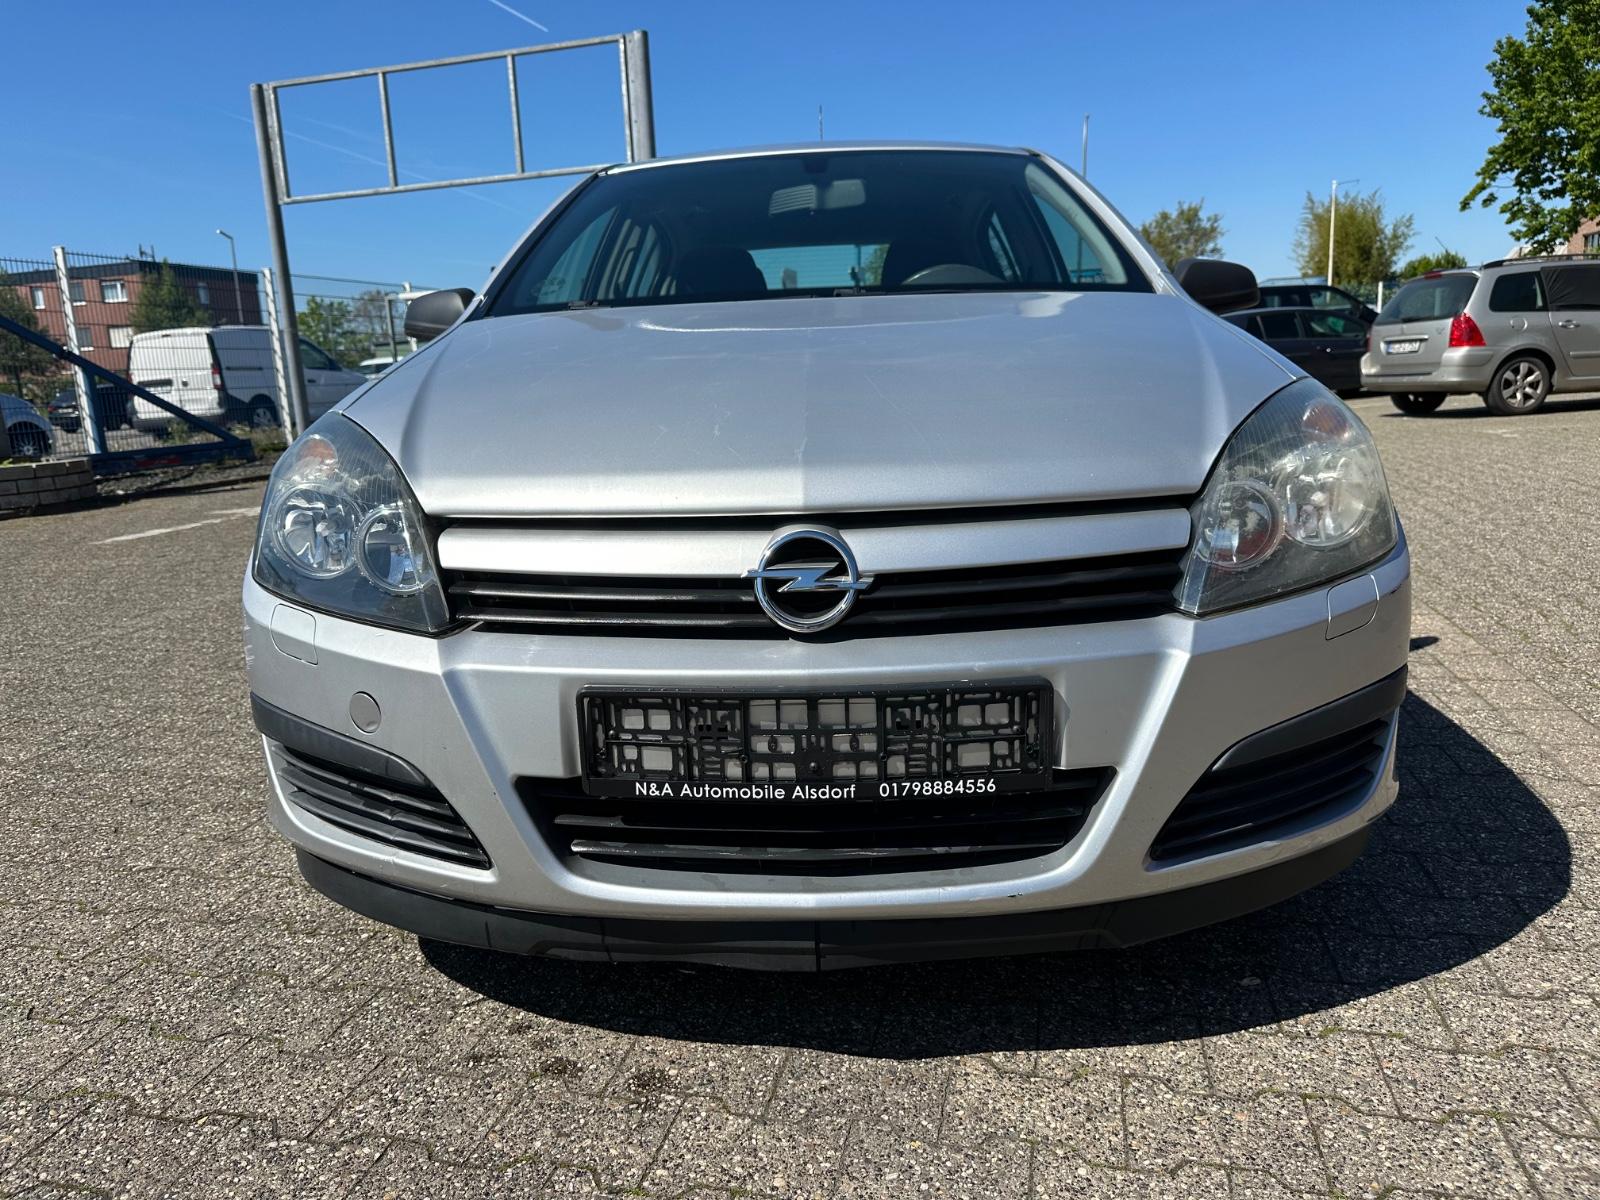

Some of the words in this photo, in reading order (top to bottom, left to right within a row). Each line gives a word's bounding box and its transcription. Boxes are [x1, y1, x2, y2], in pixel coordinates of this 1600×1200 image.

[635, 781, 673, 797] N&A
[679, 783, 786, 800] Automobile
[791, 784, 856, 800] Alsdorf
[879, 778, 996, 798] 01798884556
